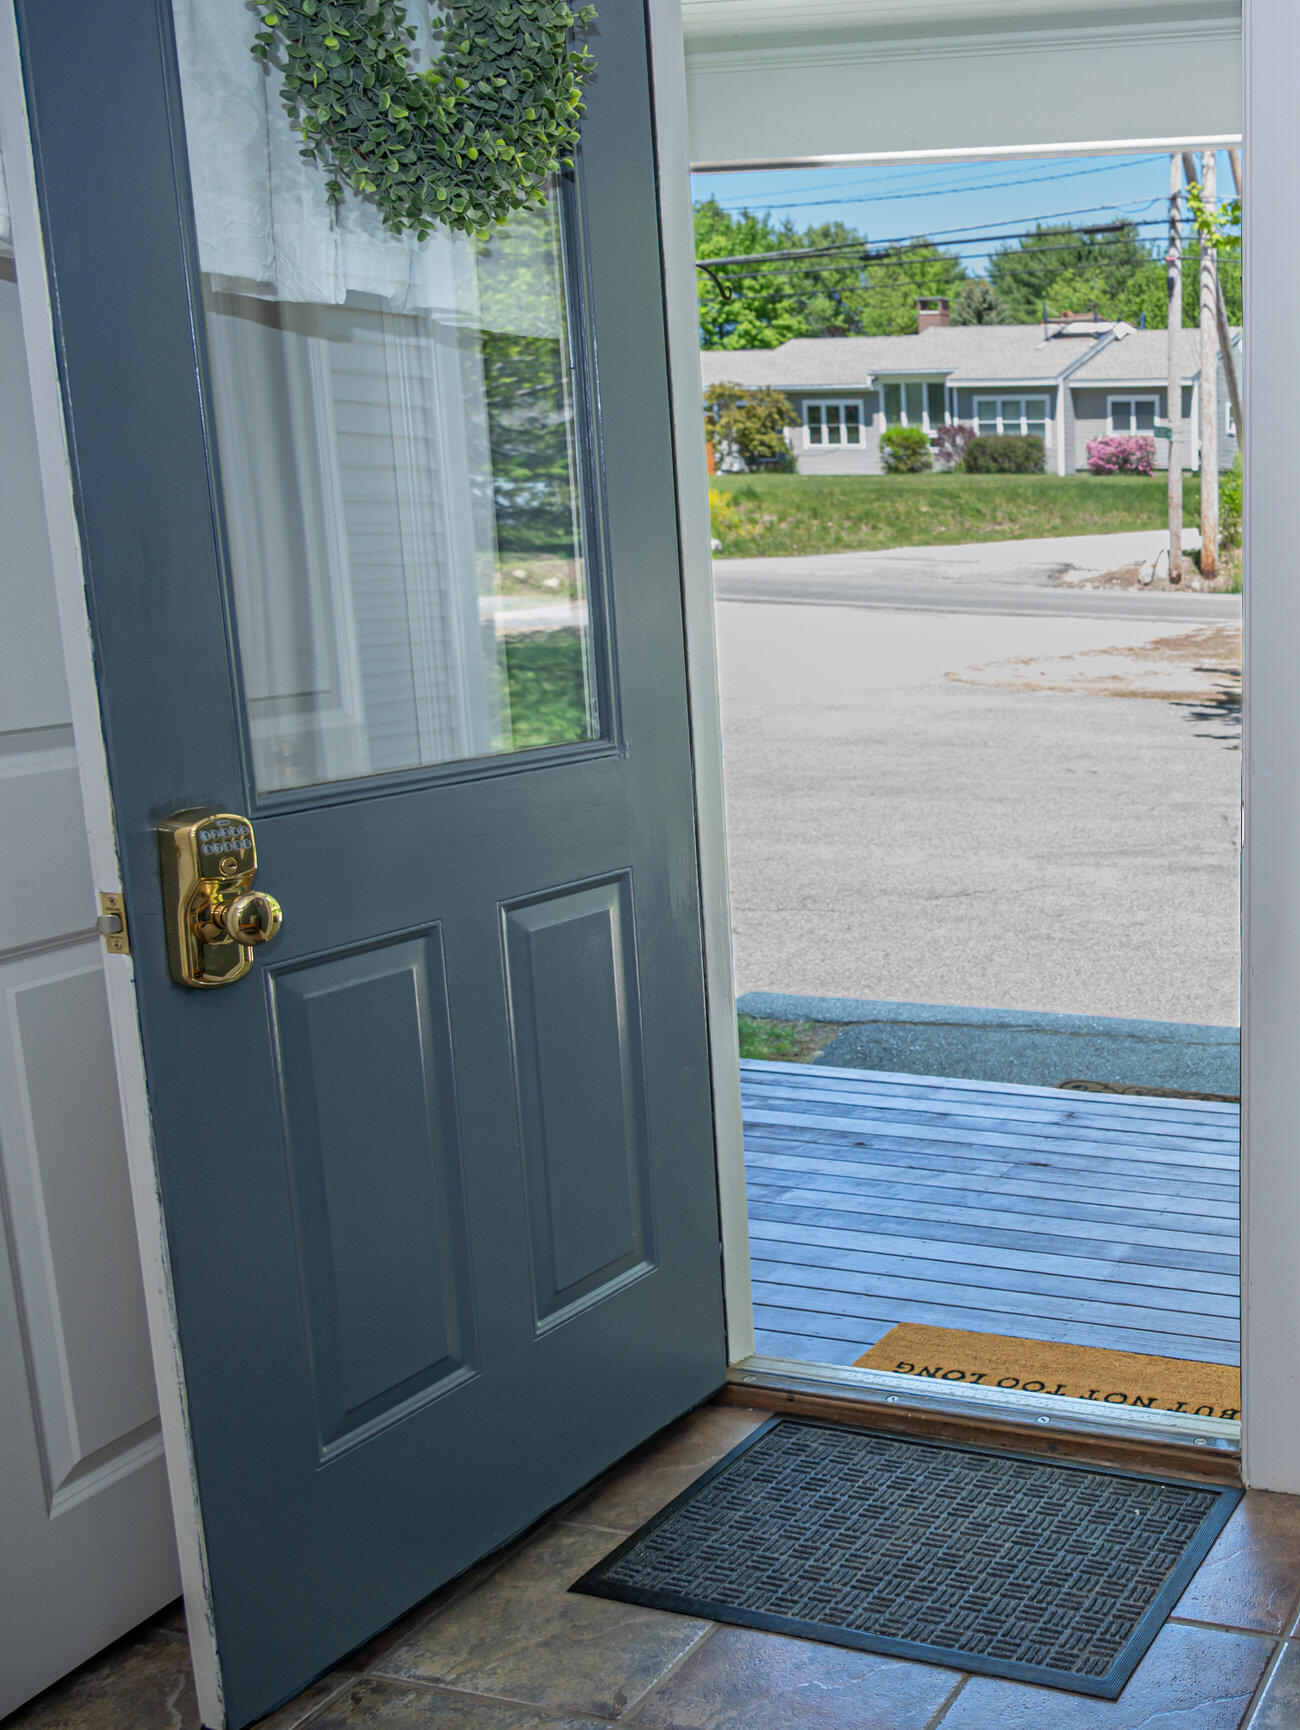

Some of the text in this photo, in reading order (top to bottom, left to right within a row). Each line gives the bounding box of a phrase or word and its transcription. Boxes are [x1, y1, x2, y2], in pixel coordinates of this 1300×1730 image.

[892, 1361, 1241, 1420] BUT NOT TOO LONG
